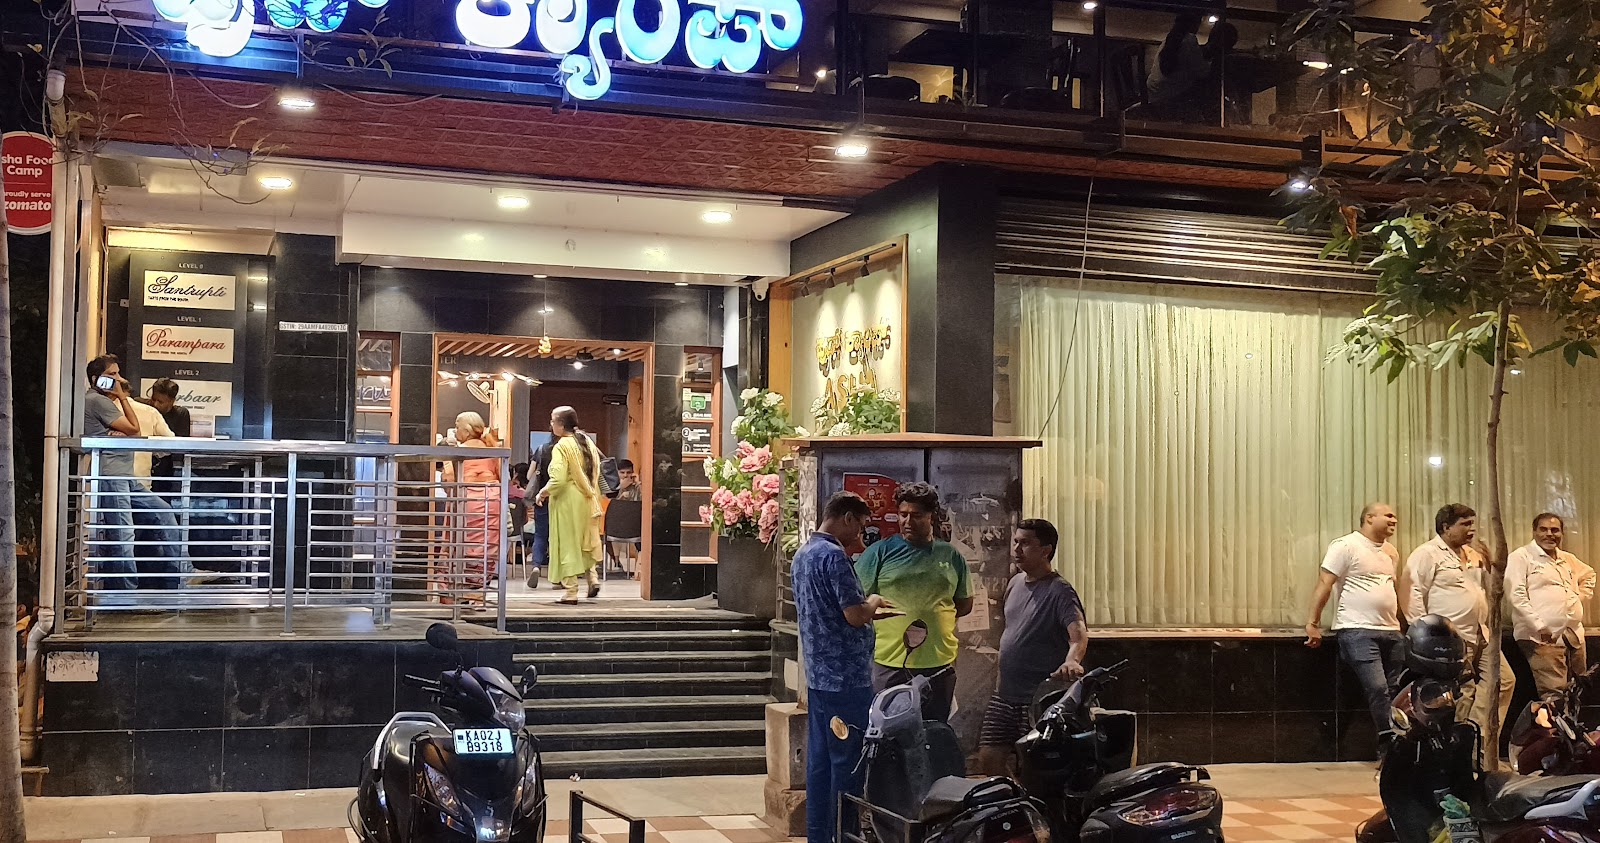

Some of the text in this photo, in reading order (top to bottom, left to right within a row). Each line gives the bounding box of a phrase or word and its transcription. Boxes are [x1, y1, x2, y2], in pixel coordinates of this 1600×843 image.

[2, 154, 23, 164] sha
[6, 165, 43, 178] Camp
[5, 190, 29, 199] roudly
[4, 200, 52, 211] zomato
[148, 274, 227, 300] Santrupti
[147, 328, 226, 354] Parampara
[440, 356, 457, 364] TER
[465, 730, 501, 741] KA02J
